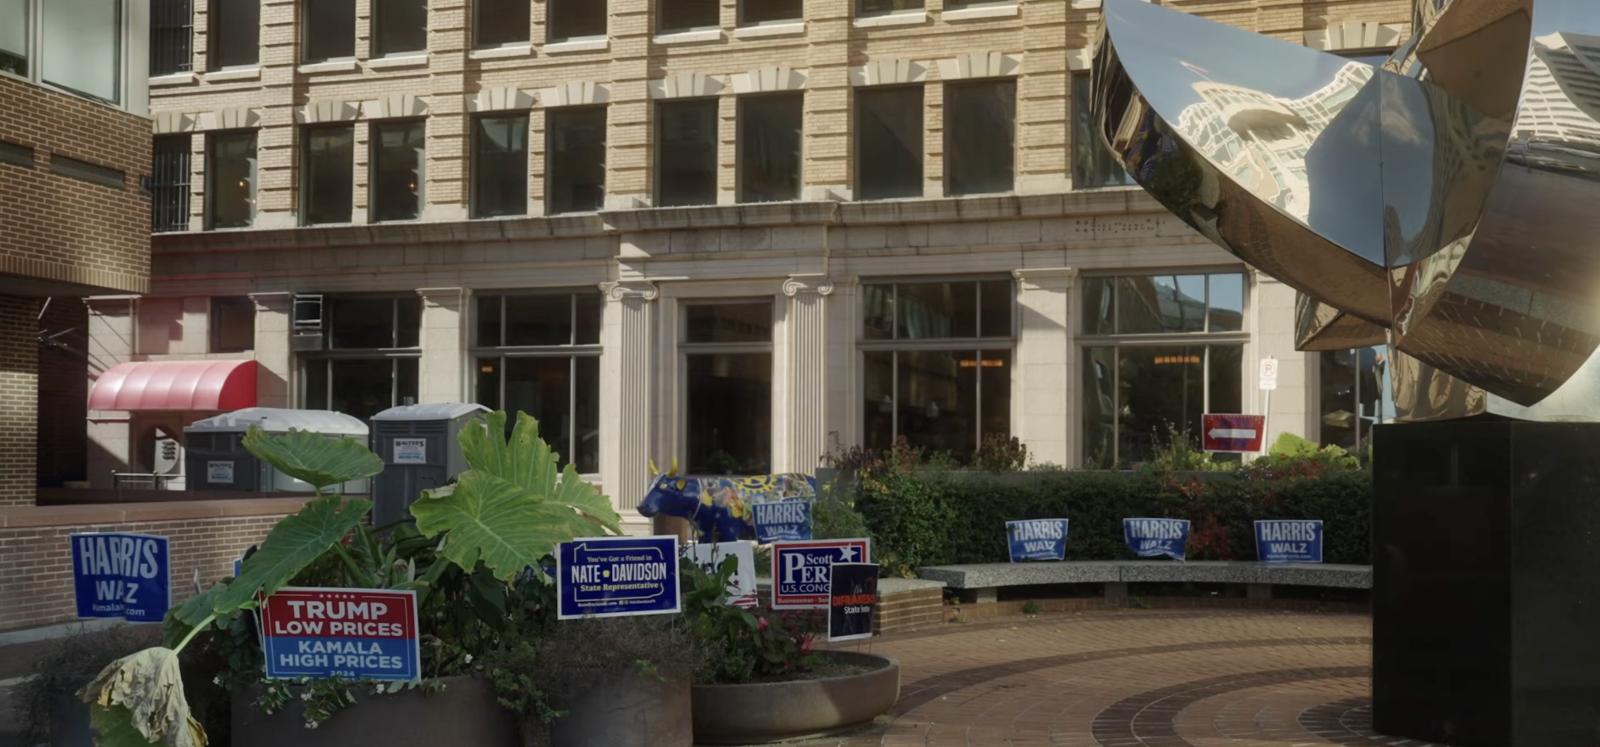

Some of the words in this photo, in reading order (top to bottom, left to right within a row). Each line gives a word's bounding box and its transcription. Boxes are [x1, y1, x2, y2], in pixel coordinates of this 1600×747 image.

[756, 503, 805, 525] HARRIS
[765, 524, 798, 537] WALZ
[1014, 521, 1063, 541] HARRIS
[1130, 520, 1183, 540] HARRIS
[1261, 522, 1316, 541] HARRIS
[1024, 540, 1056, 552] WALZ
[1140, 540, 1173, 550] WALZ
[1270, 542, 1307, 553] WALZ
[79, 536, 158, 579] HARRIS
[806, 553, 833, 565] Scott
[571, 564, 601, 583] NATE
[612, 562, 667, 582] DAVIDSON
[782, 552, 830, 583] PER
[95, 580, 139, 604] WAZ
[580, 584, 602, 592] State
[602, 582, 660, 592] Representative
[799, 583, 830, 592] CONG
[287, 600, 388, 620] TRUMP
[844, 605, 861, 615] State
[274, 621, 324, 635] LOW
[330, 621, 403, 637] PRICES
[298, 640, 383, 655] KAMALA
[280, 653, 329, 668] HIGH
[334, 654, 403, 669] PRICES
[330, 670, 355, 678] 2024
